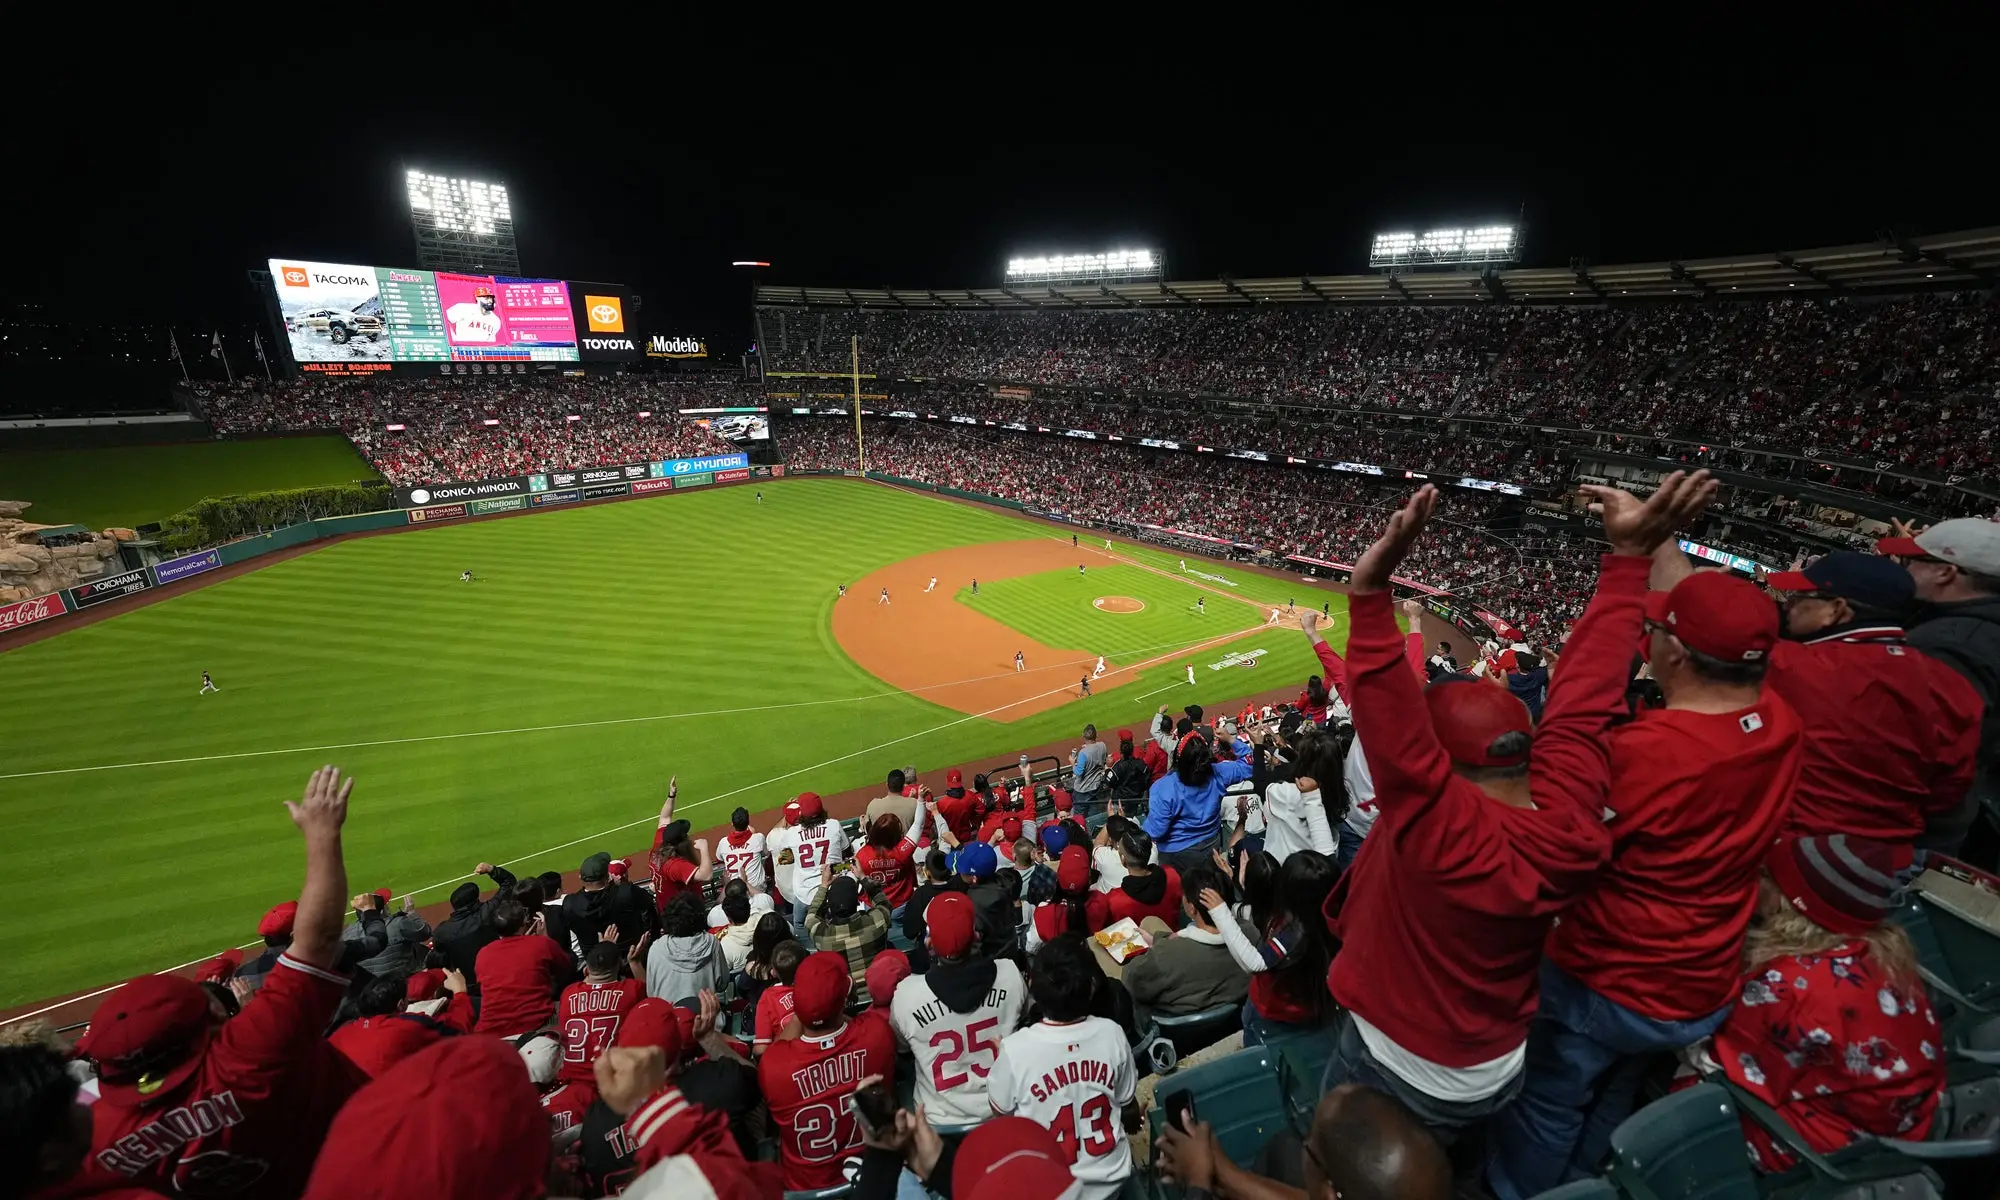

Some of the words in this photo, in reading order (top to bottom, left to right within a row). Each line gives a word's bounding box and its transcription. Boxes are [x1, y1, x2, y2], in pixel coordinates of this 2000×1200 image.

[313, 274, 369, 286] TACOMA
[582, 338, 634, 350] TOYOTA
[652, 335, 699, 353] Modelo
[348, 363, 392, 371] BOURBON
[693, 457, 741, 470] HYUNDAI
[433, 487, 475, 499] KONICA
[477, 482, 521, 494] MINOLTA
[635, 479, 669, 490] Yakult
[426, 507, 462, 515] PECHANGA
[487, 498, 521, 509] National
[1537, 510, 1568, 521] LEXUS
[160, 559, 207, 578] MemorialCare
[93, 573, 142, 593] YOKOHAMA
[122, 581, 145, 594] TIRES
[798, 826, 828, 842] TROUT
[726, 852, 754, 873] 27
[798, 840, 830, 869] 27
[568, 989, 624, 1015] TROUT
[563, 1015, 620, 1062] 27
[929, 1016, 1000, 1092] 25
[792, 1049, 867, 1100] TROUT
[1030, 1059, 1115, 1103] SANDOVAL
[97, 1090, 245, 1177] RENDON
[1048, 1093, 1117, 1165] 43
